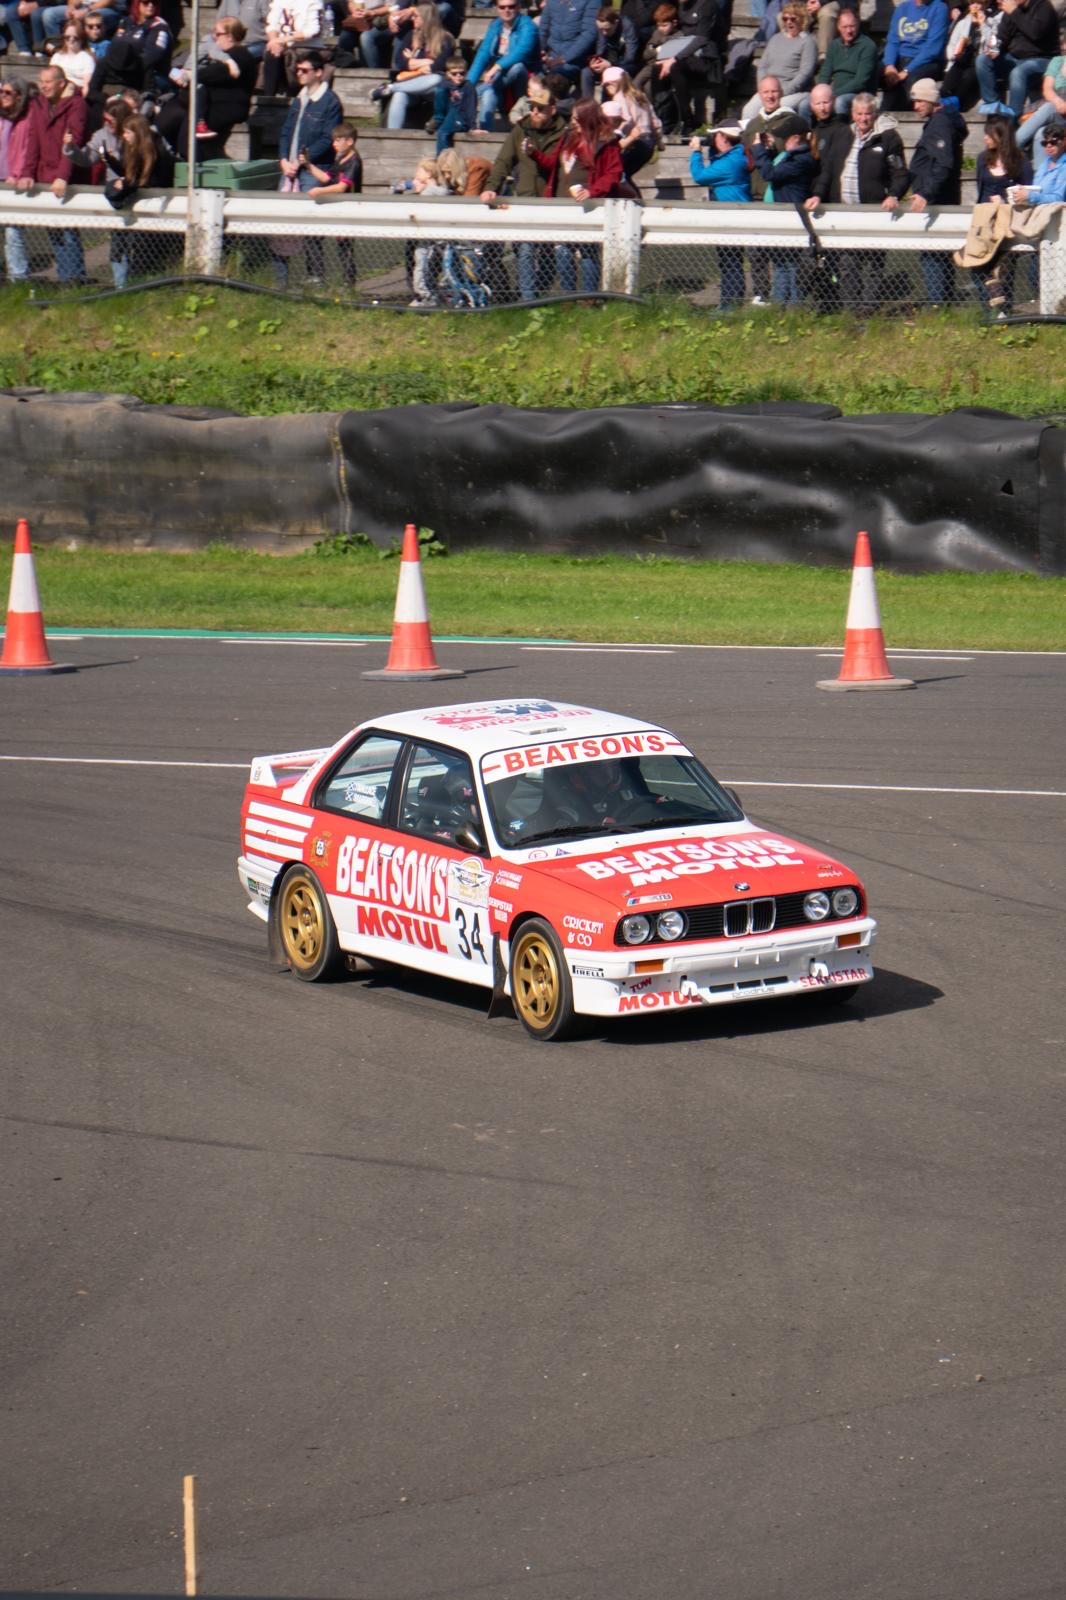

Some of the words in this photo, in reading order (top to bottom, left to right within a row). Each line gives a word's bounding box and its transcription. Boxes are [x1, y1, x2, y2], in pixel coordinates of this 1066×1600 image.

[503, 734, 667, 773] BEATSON'S
[336, 835, 449, 918] BEATSON'S
[576, 837, 798, 880] BEATSON'S
[630, 853, 804, 887] MOTUL
[357, 905, 449, 954] MOTUL
[455, 908, 488, 965] 34
[563, 915, 604, 934] CRICKET
[567, 931, 575, 943] &
[577, 933, 593, 947] CO
[572, 964, 604, 978] PIRELLI
[630, 977, 652, 993] TOW
